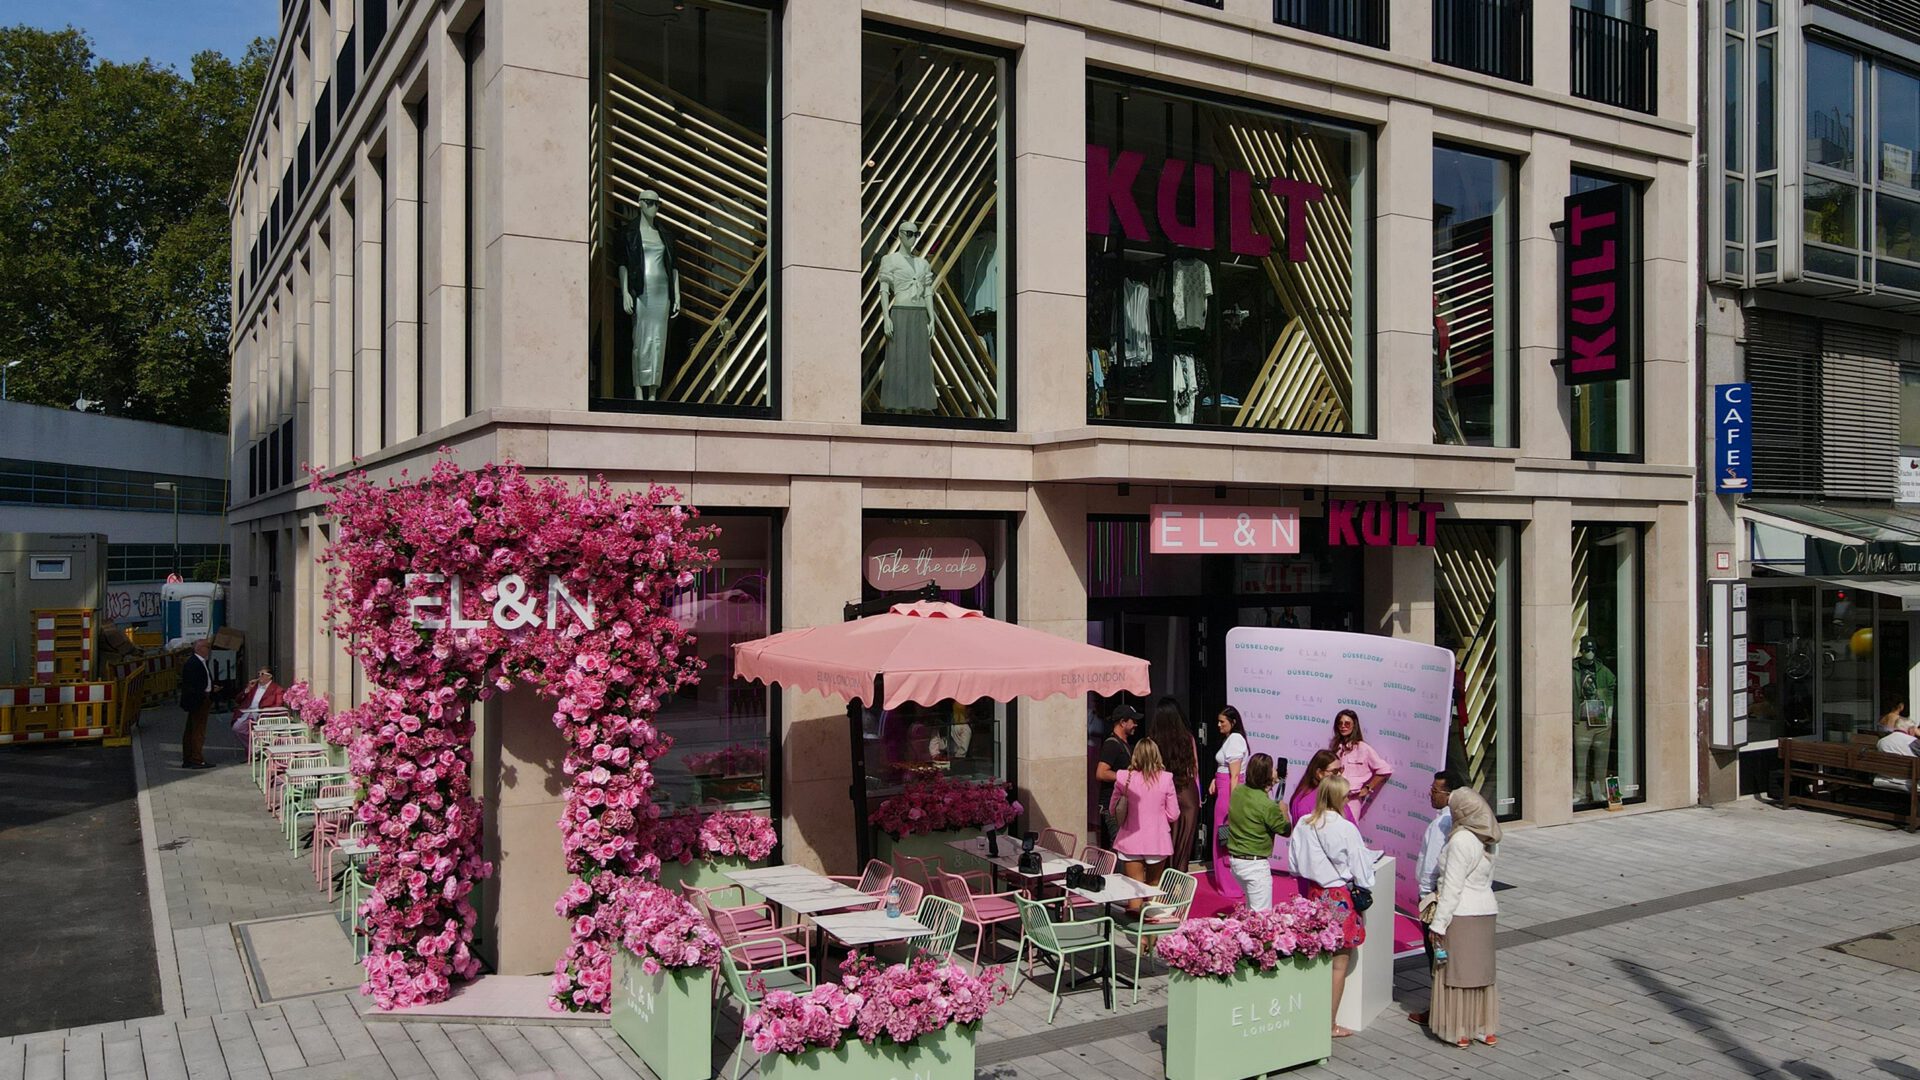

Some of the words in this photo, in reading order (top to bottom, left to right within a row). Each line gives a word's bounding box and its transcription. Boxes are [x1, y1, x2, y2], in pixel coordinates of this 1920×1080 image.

[1087, 143, 1323, 262] KULT
[1572, 204, 1616, 374] KULT
[1723, 387, 1743, 466] CAFE
[1328, 499, 1445, 547] KULT
[872, 548, 909, 580] Take
[912, 547, 942, 576] the
[945, 548, 977, 577] cake
[405, 573, 595, 630] EL&N
[1235, 643, 1284, 652] DÜSSELDORF
[1342, 652, 1384, 663] DÜSSELDORF
[1061, 673, 1084, 684] EL&N
[1088, 672, 1126, 682] LONDON
[1287, 669, 1333, 679] DÜSSELDORF
[1234, 687, 1280, 696] DÜSSELDORF
[1383, 681, 1416, 693] DÜSSELDORF
[1337, 698, 1377, 709] DÜSSELDORF
[1285, 714, 1330, 724] DÜSSELDORF
[1379, 729, 1411, 741] DÜSSELDORF
[1232, 992, 1302, 1026] EL&N
[1243, 1019, 1290, 1037] LONDON
